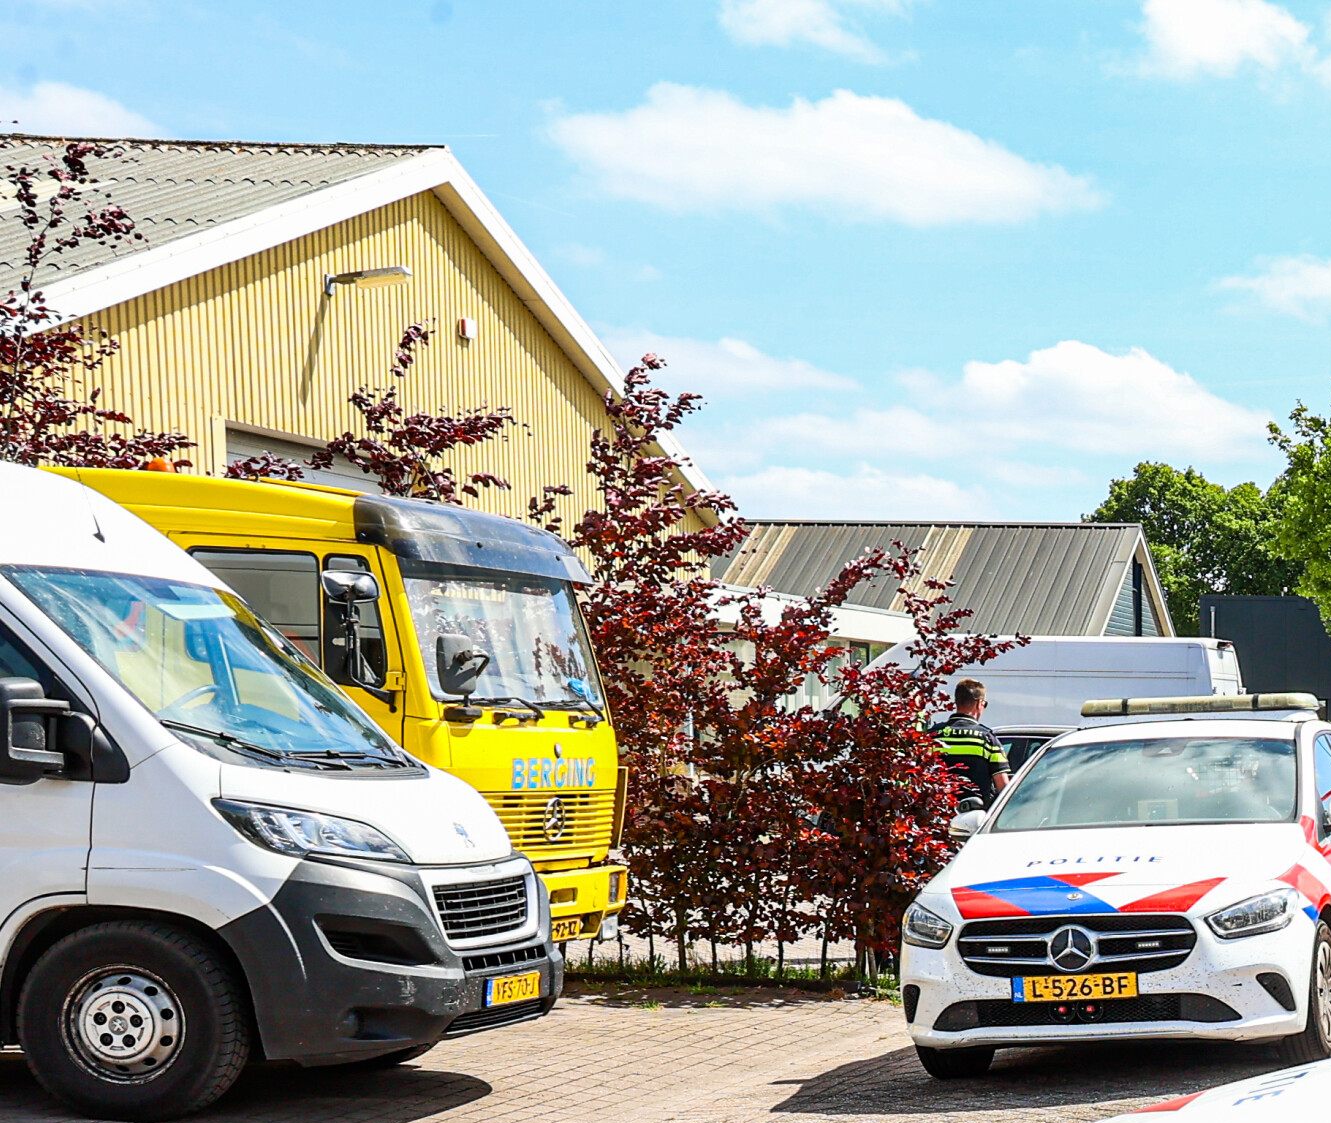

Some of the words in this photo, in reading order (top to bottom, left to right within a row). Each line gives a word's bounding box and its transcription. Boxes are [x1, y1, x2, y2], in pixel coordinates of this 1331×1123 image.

[512, 757, 596, 790] BERGING
[1026, 855, 1164, 868] POLITIE
[496, 976, 536, 1001] VFS-70-J
[1014, 991, 1023, 999] NL
[1031, 975, 1129, 999] L-526-BF
